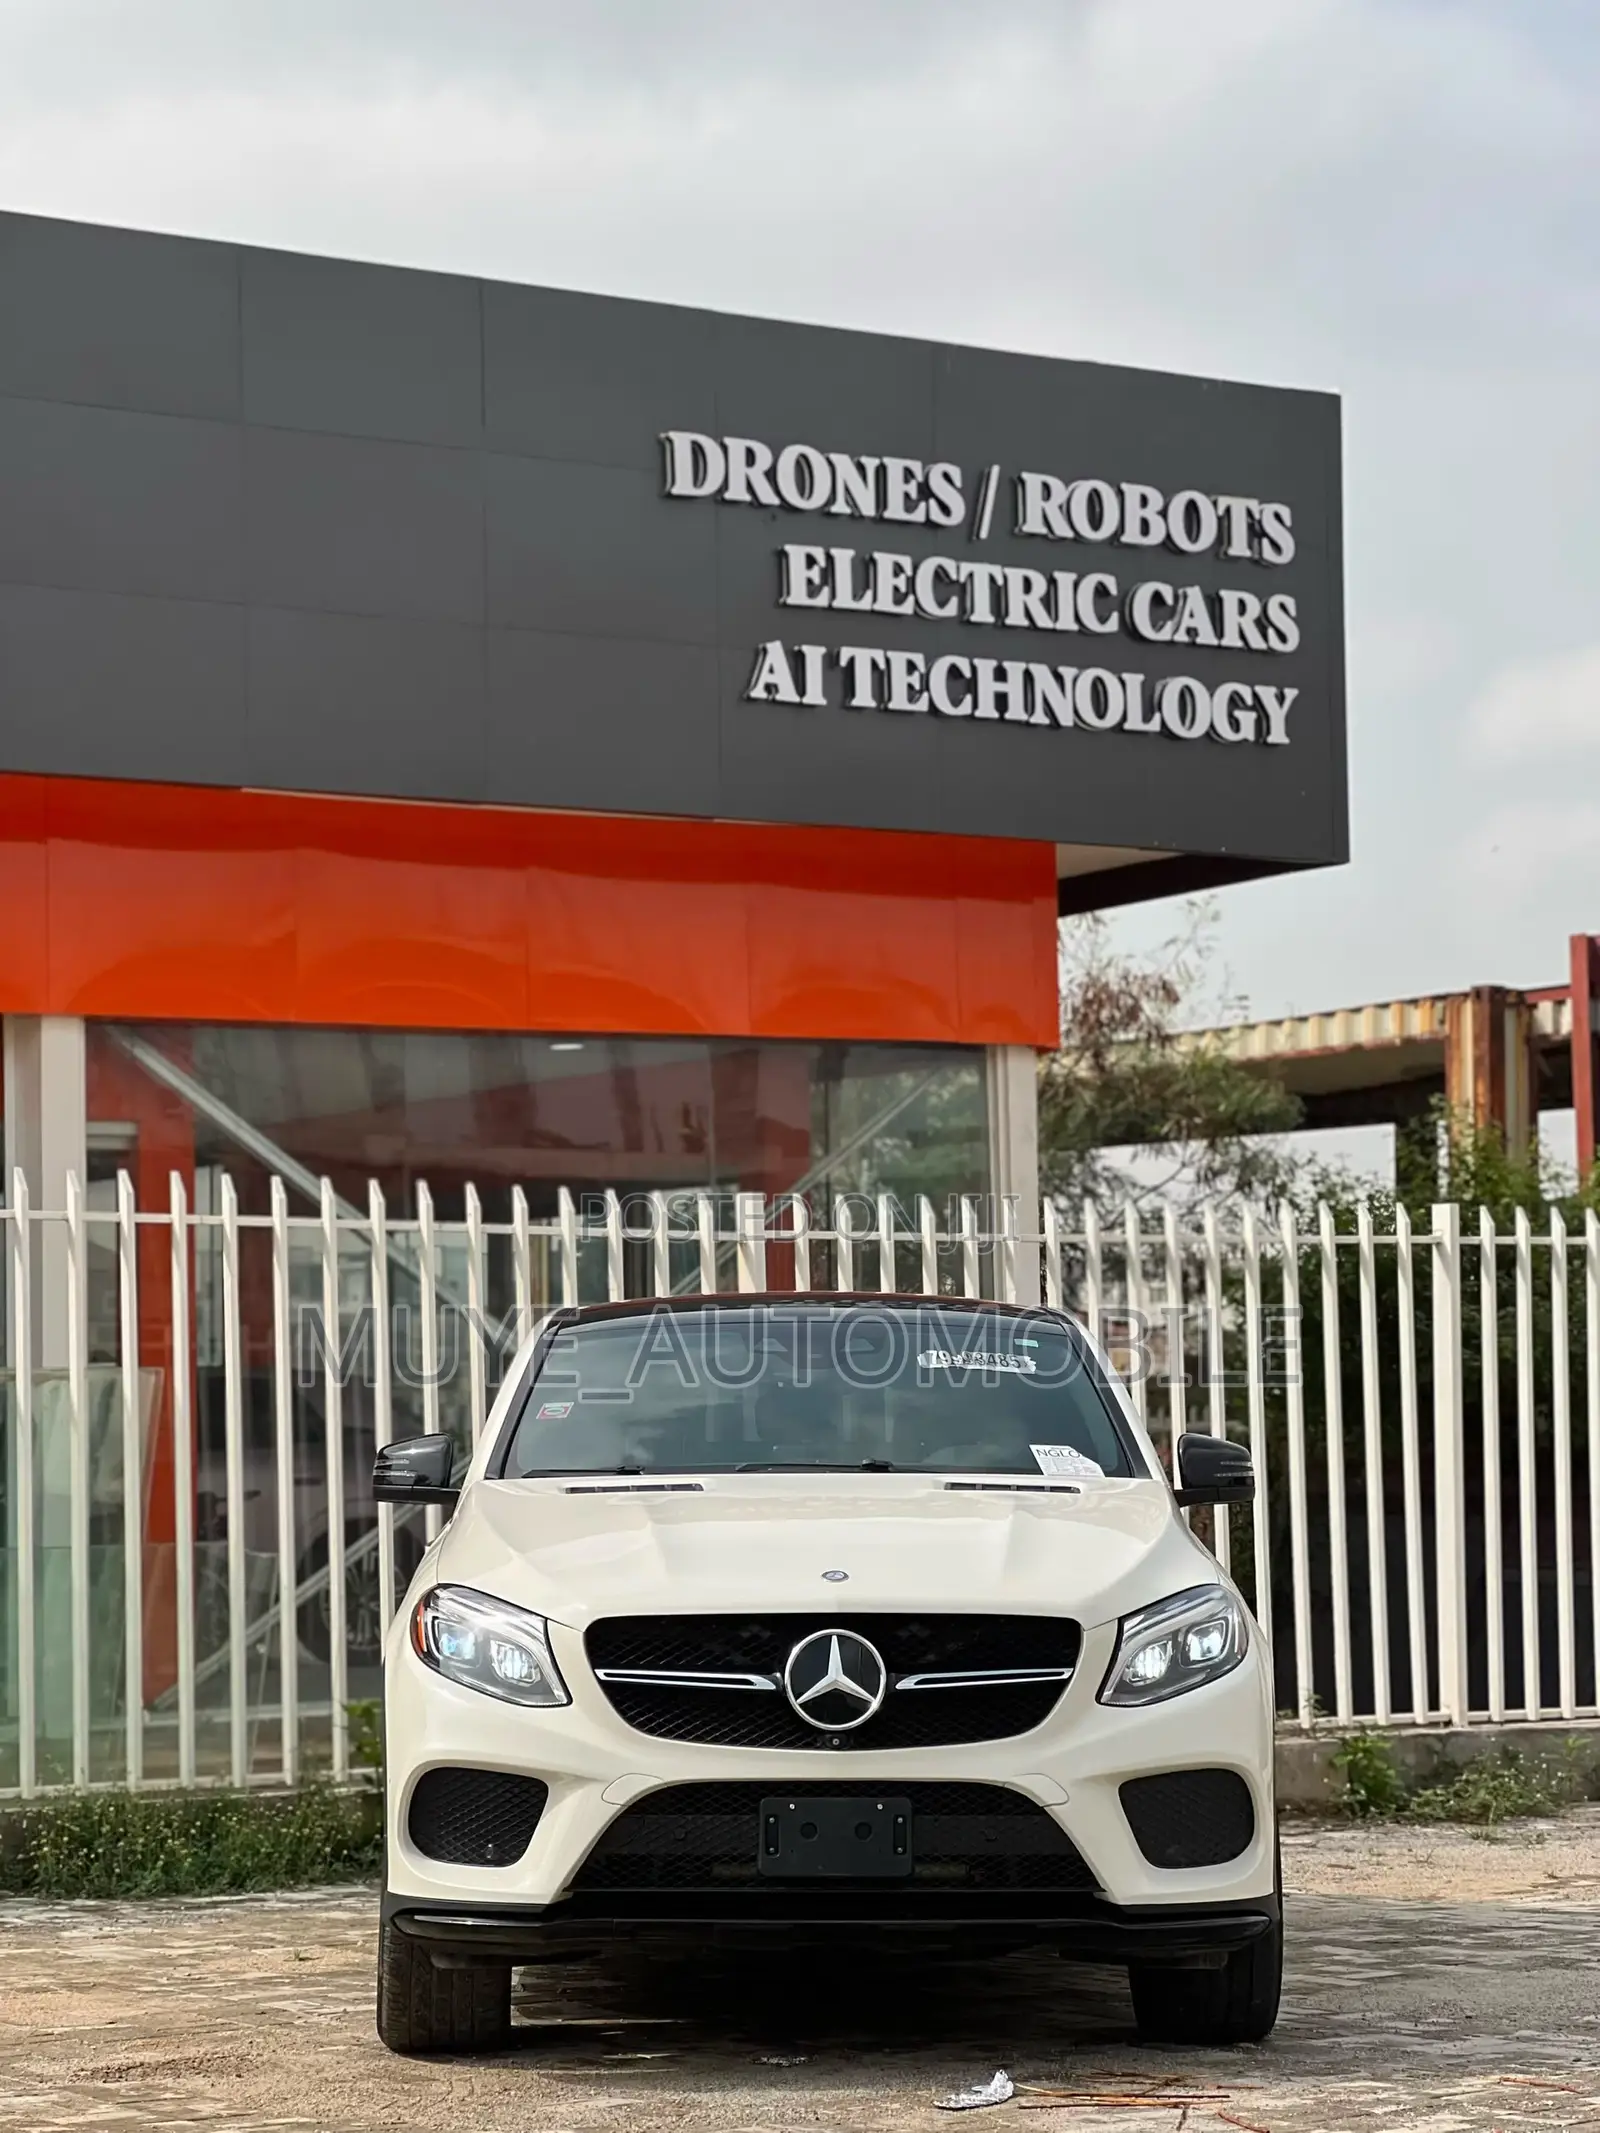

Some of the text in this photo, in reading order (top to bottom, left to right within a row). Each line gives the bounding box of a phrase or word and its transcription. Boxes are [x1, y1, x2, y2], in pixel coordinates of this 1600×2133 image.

[660, 431, 966, 527] DRONES
[1015, 471, 1296, 565] ROBOTS
[779, 544, 1300, 653] ELECTRIC CARS
[745, 639, 1299, 744] AI TECHNOLOGY
